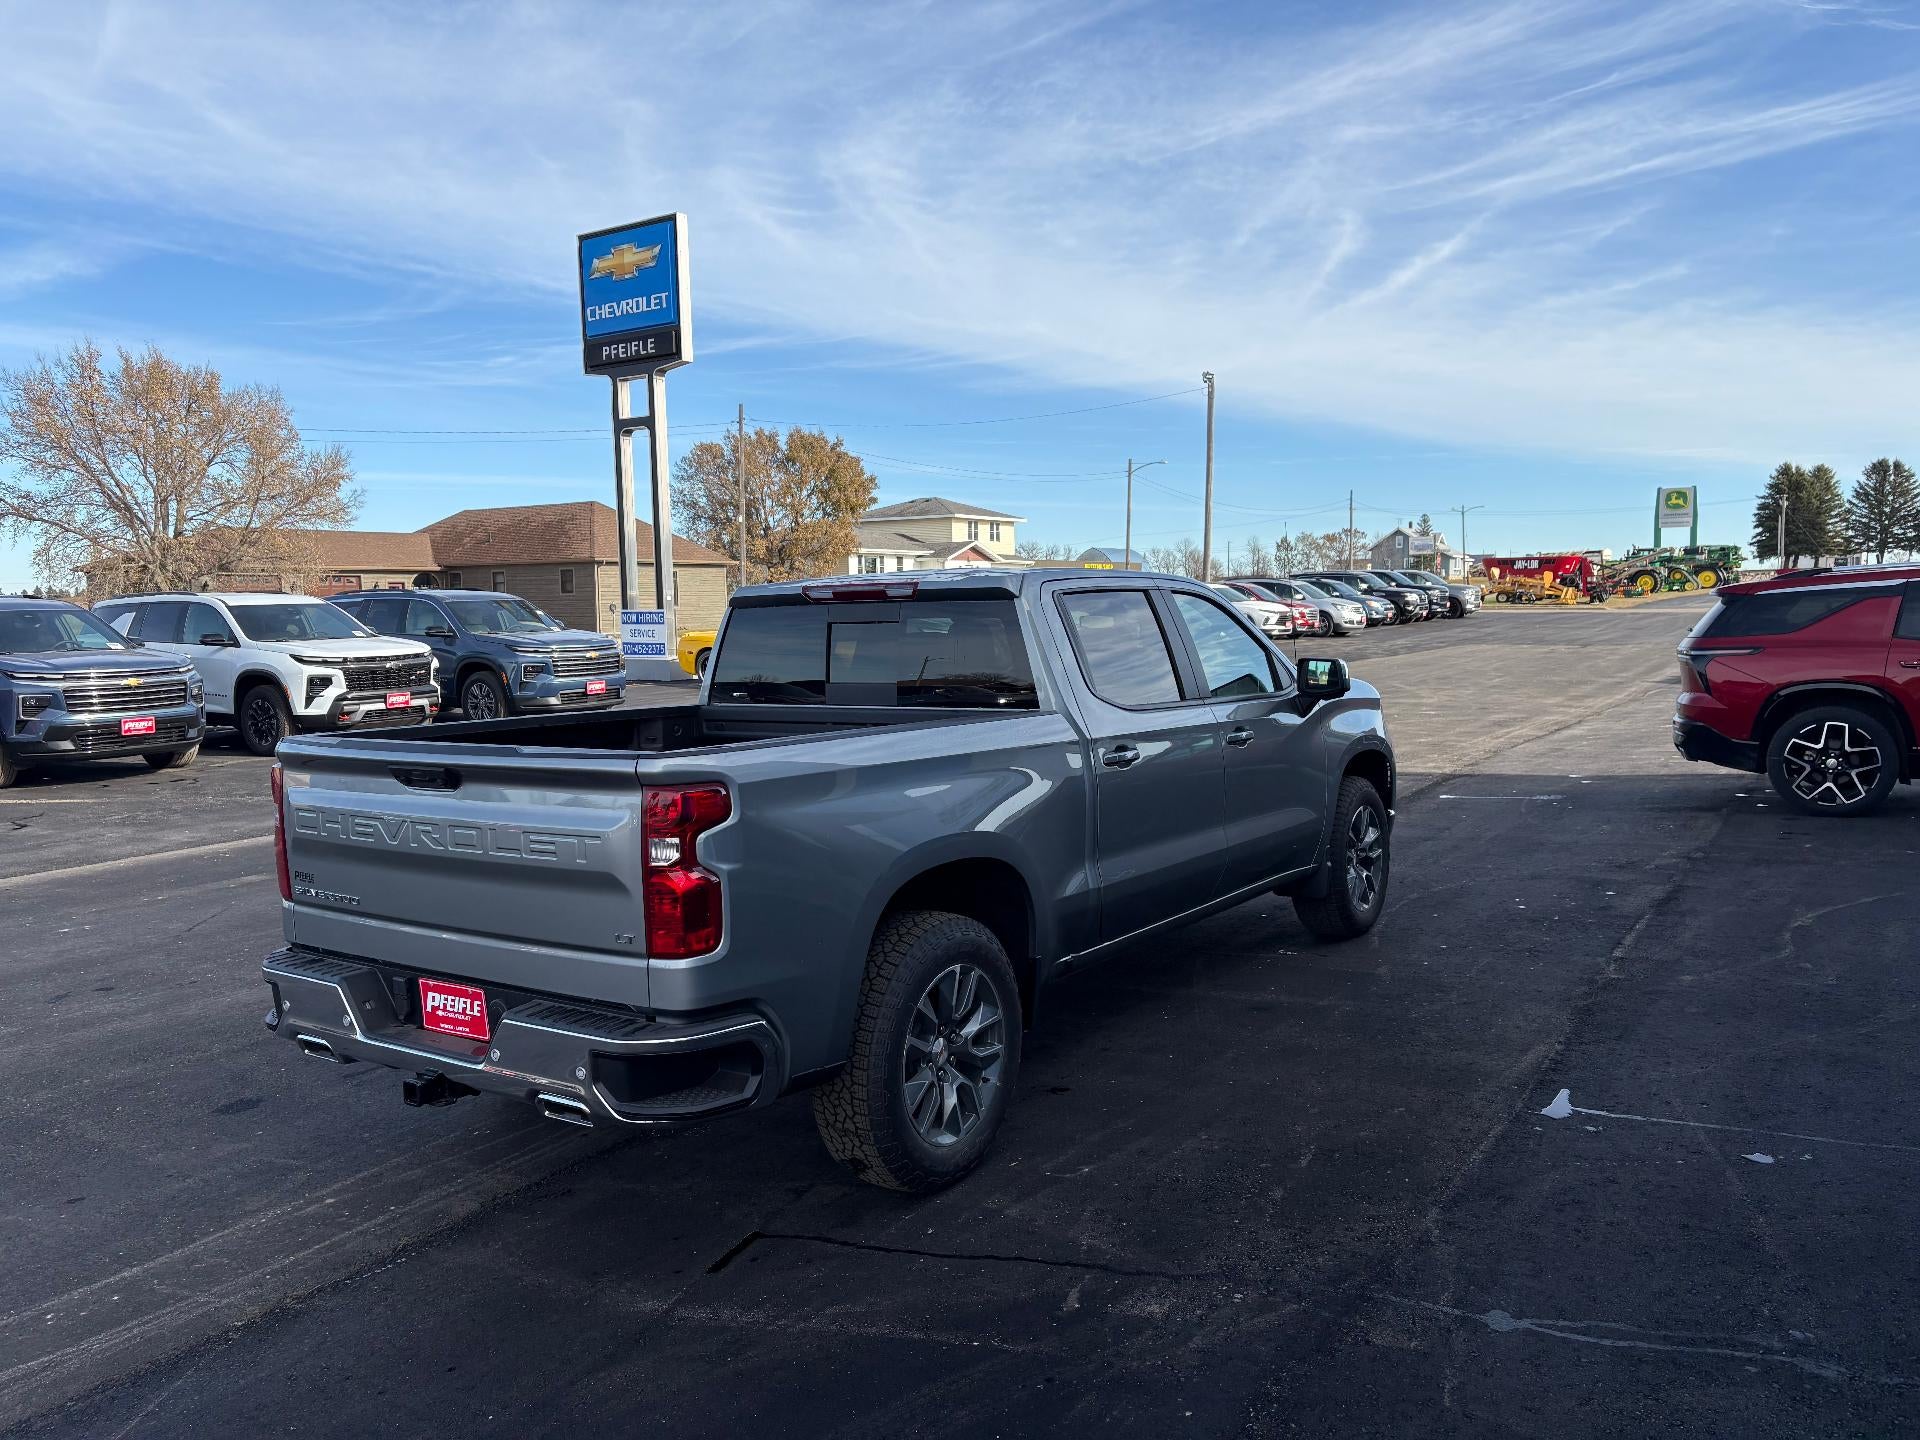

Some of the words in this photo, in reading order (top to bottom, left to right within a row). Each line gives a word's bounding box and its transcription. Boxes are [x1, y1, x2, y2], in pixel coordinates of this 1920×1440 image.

[586, 292, 669, 322] CHEVROLET
[602, 338, 656, 360] PFEIFLE
[622, 613, 637, 624] NOW
[638, 613, 664, 624] HIRING
[629, 628, 656, 639] SERVICE
[294, 807, 602, 864] CHEVROLET
[425, 991, 482, 1017] PFEIFLE
